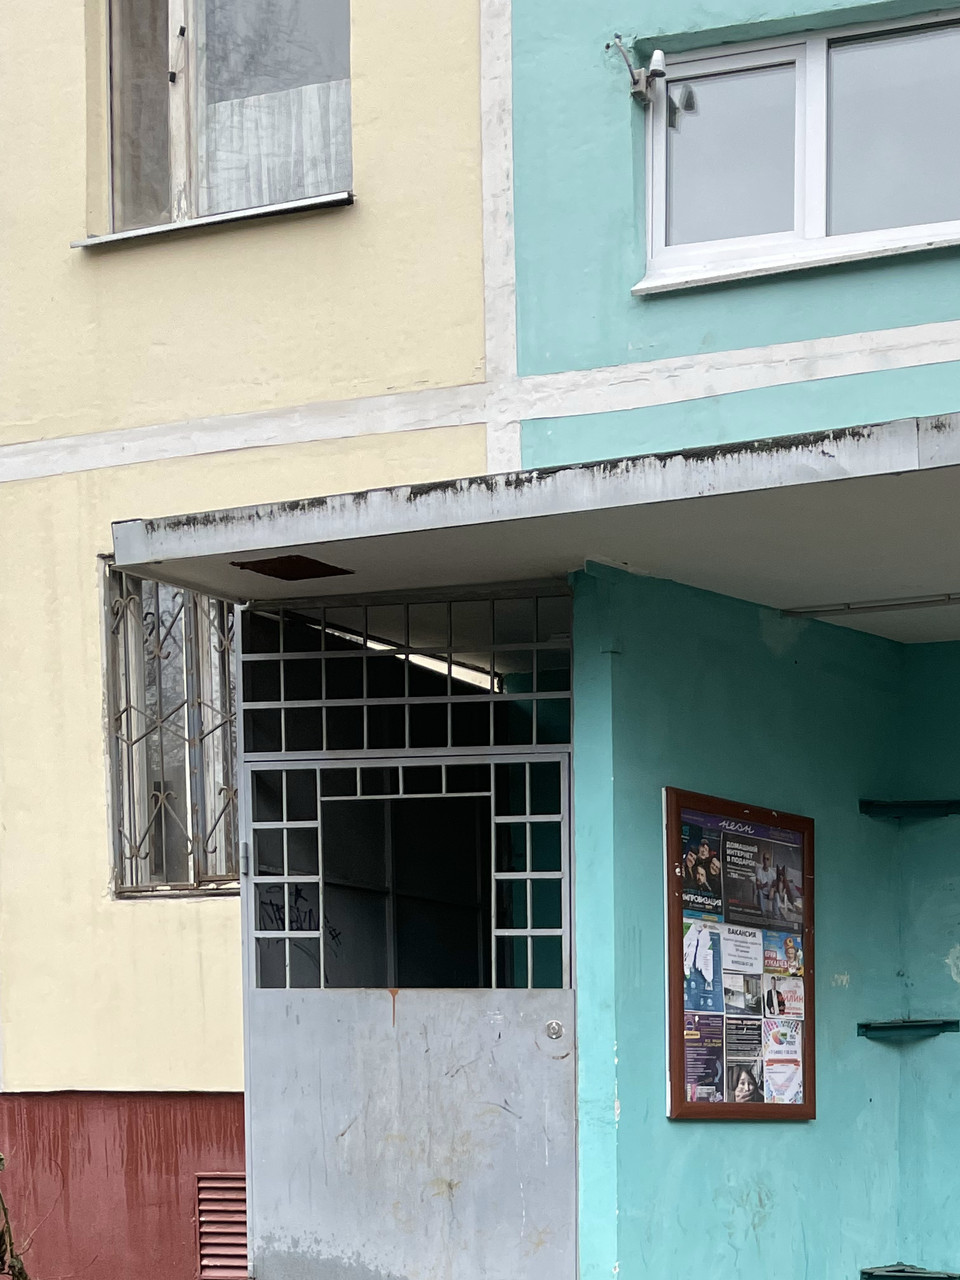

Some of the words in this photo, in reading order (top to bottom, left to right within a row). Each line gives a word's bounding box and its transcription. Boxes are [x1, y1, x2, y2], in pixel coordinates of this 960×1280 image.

[726, 841, 758, 853] ДОМАШНИЙ
[726, 849, 753, 859] ИНТЕРНЕТ
[727, 927, 757, 938] ВАКАНСИЯ
